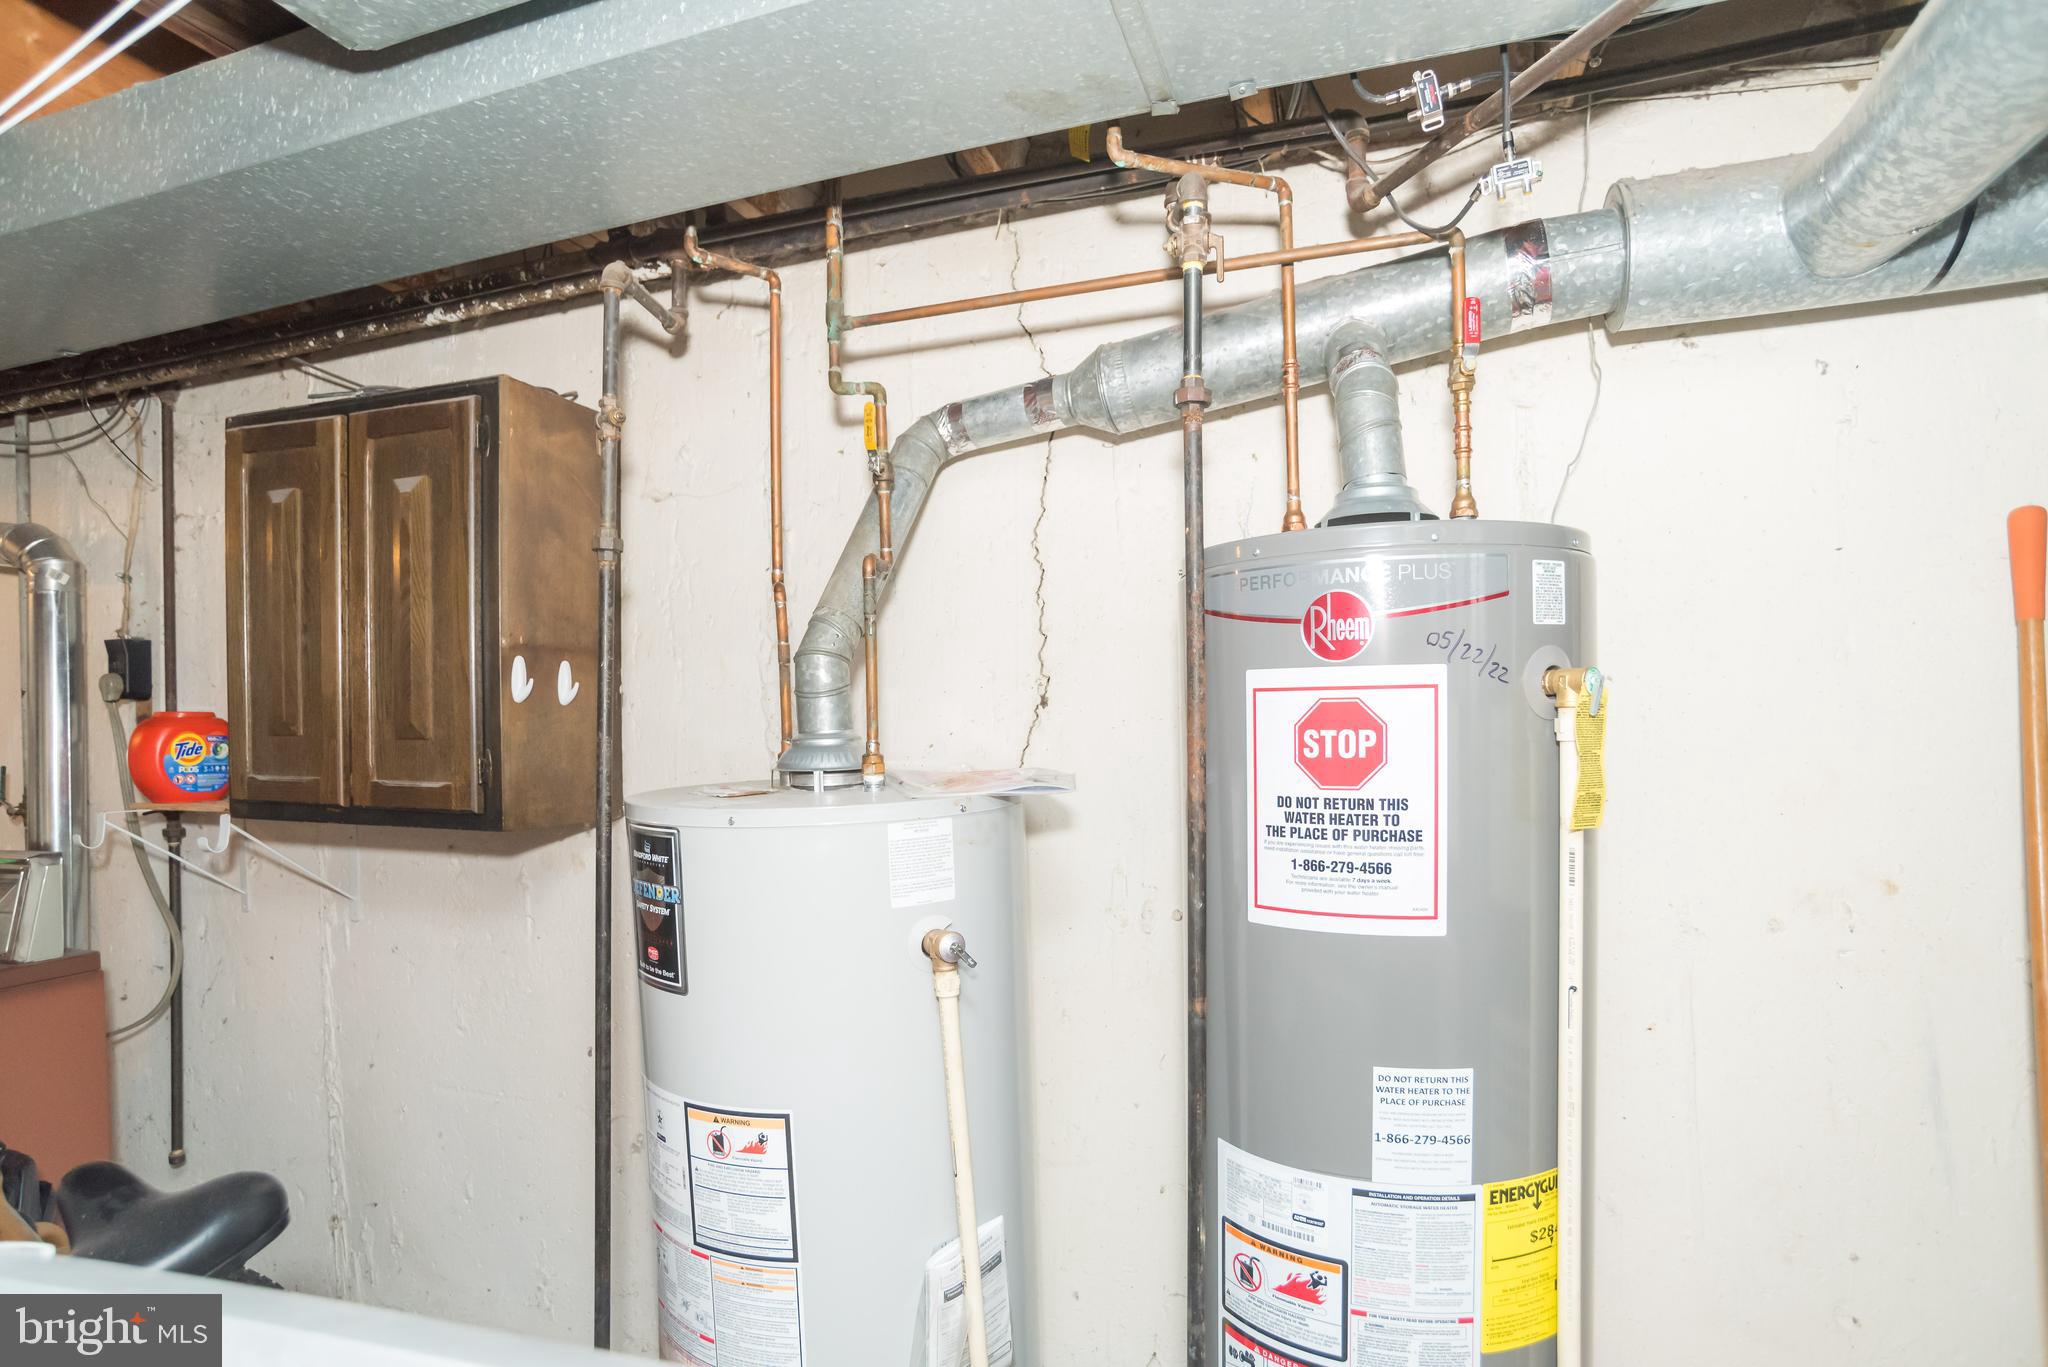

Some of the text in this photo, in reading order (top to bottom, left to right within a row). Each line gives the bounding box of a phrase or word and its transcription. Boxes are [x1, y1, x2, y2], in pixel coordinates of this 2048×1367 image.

[1398, 563, 1452, 581] PLUS
[1310, 593, 1370, 651] Rheem
[1427, 629, 1510, 684] 05/22/22
[175, 741, 203, 760] Tide
[1303, 729, 1377, 758] STOP
[1277, 796, 1409, 811] DO NOT RETURN THIS
[1284, 811, 1400, 826] WATER HEATER TO
[1266, 825, 1423, 842] THE PLACE OF PURCHASE
[652, 853, 669, 863] WHITE
[1291, 859, 1392, 874] 1-866-279-4566
[634, 879, 681, 904] EFENDER
[649, 904, 670, 916] SYSTEM
[662, 969, 675, 978] Best
[1378, 1075, 1391, 1083] DO
[1394, 1075, 1412, 1083] NOT
[1375, 1086, 1470, 1095] WATER HEATER TO THE
[1380, 1098, 1406, 1106] PLACE
[720, 1117, 751, 1127] WARNING
[1374, 1132, 1471, 1145] 1-866-279-4566
[1369, 1192, 1402, 1200] INSTALLATION
[1259, 1243, 1304, 1264] WARNING
[1263, 1350, 1300, 1367] DANGER
